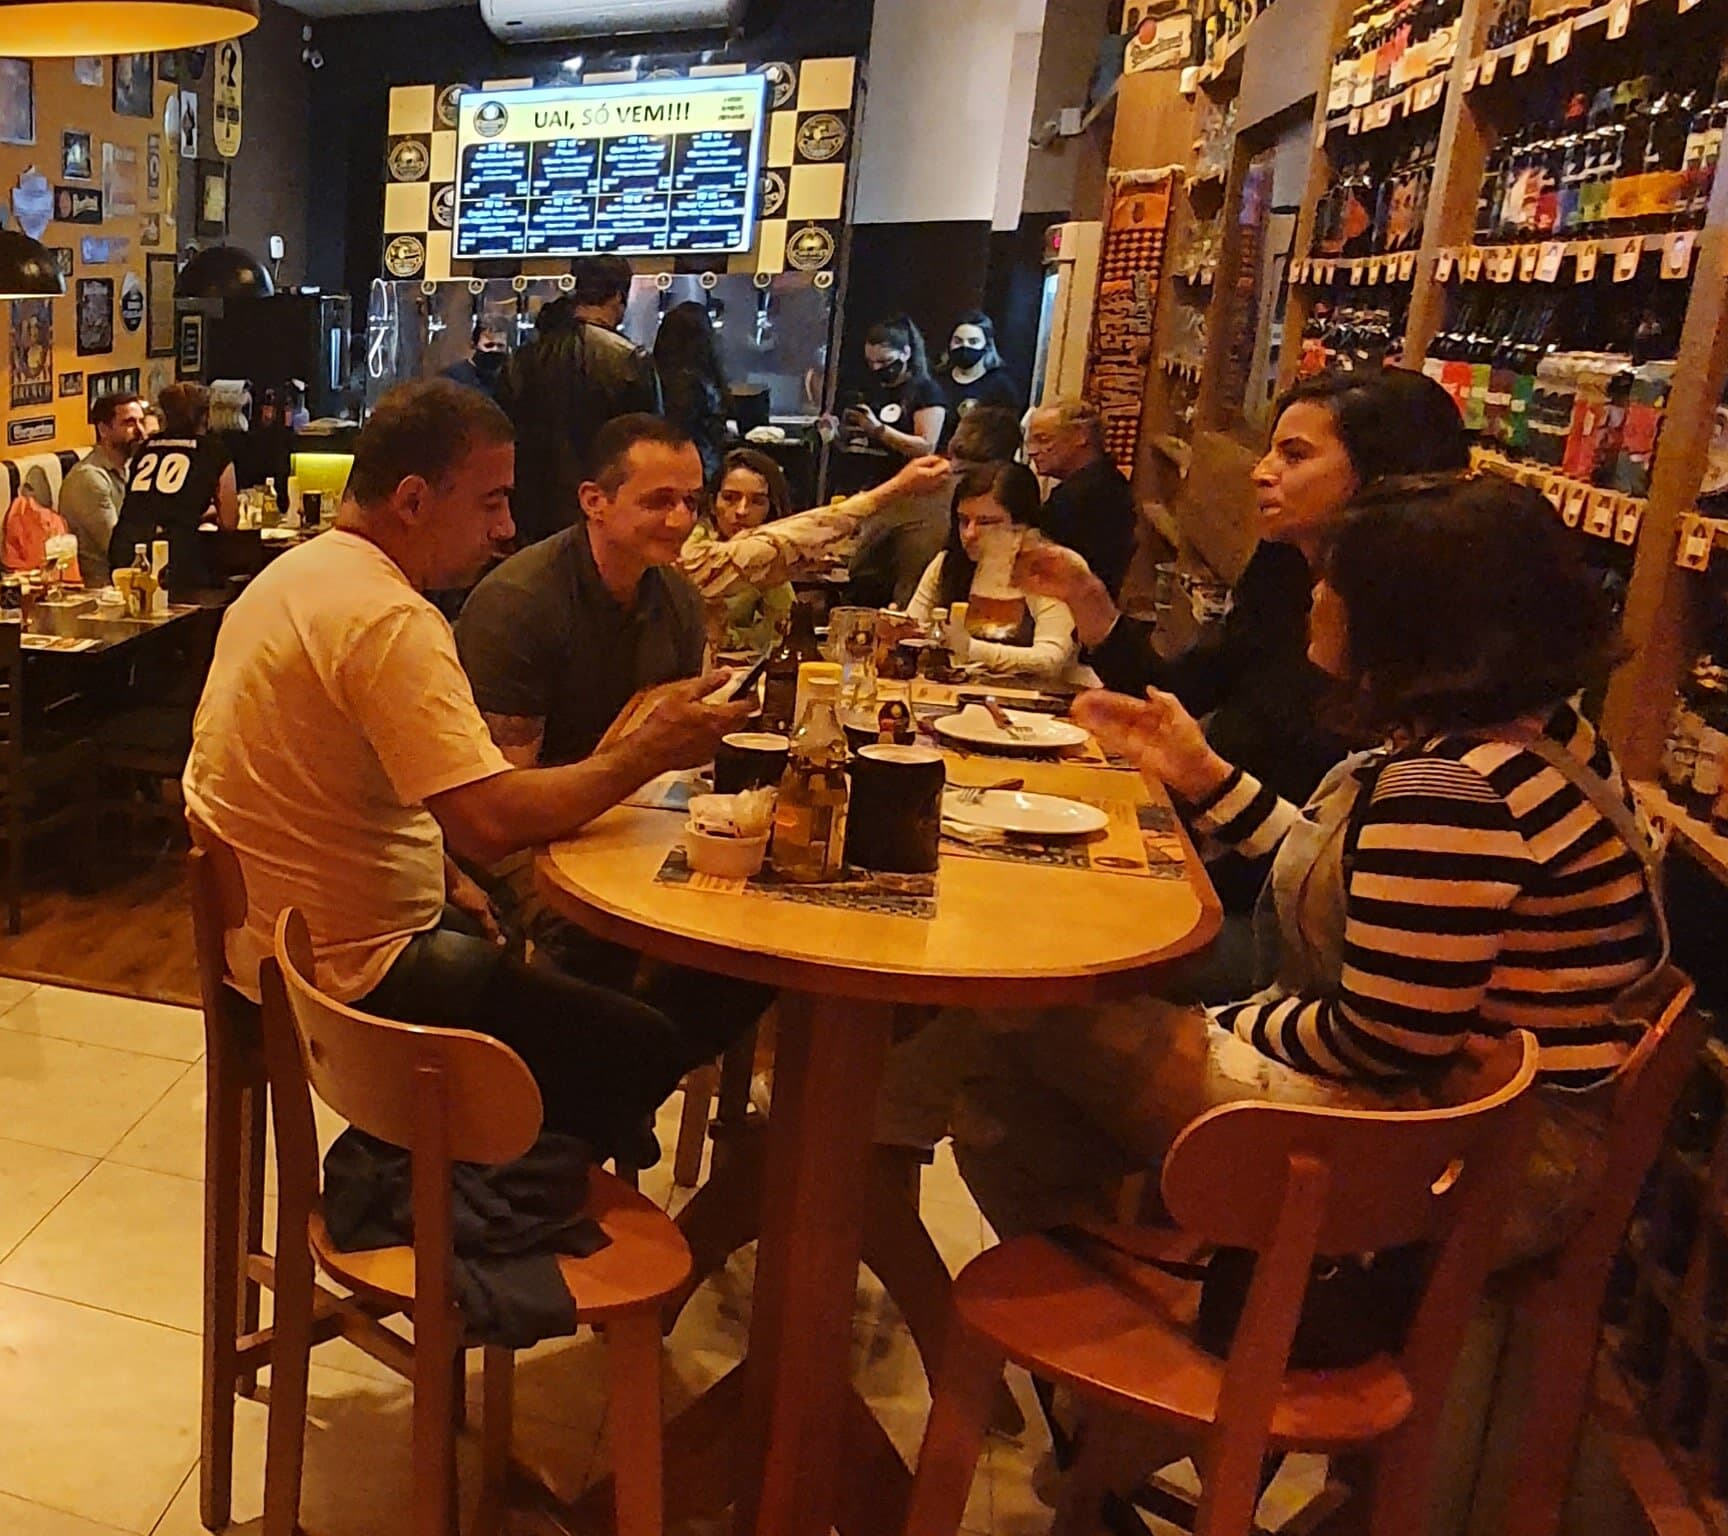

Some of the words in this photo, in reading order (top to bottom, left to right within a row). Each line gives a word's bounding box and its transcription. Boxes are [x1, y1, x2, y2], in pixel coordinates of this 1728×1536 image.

[534, 110, 575, 130] UAI,
[581, 102, 610, 126] SÓ
[616, 102, 690, 124] VEM!!!
[130, 452, 191, 494] 20
